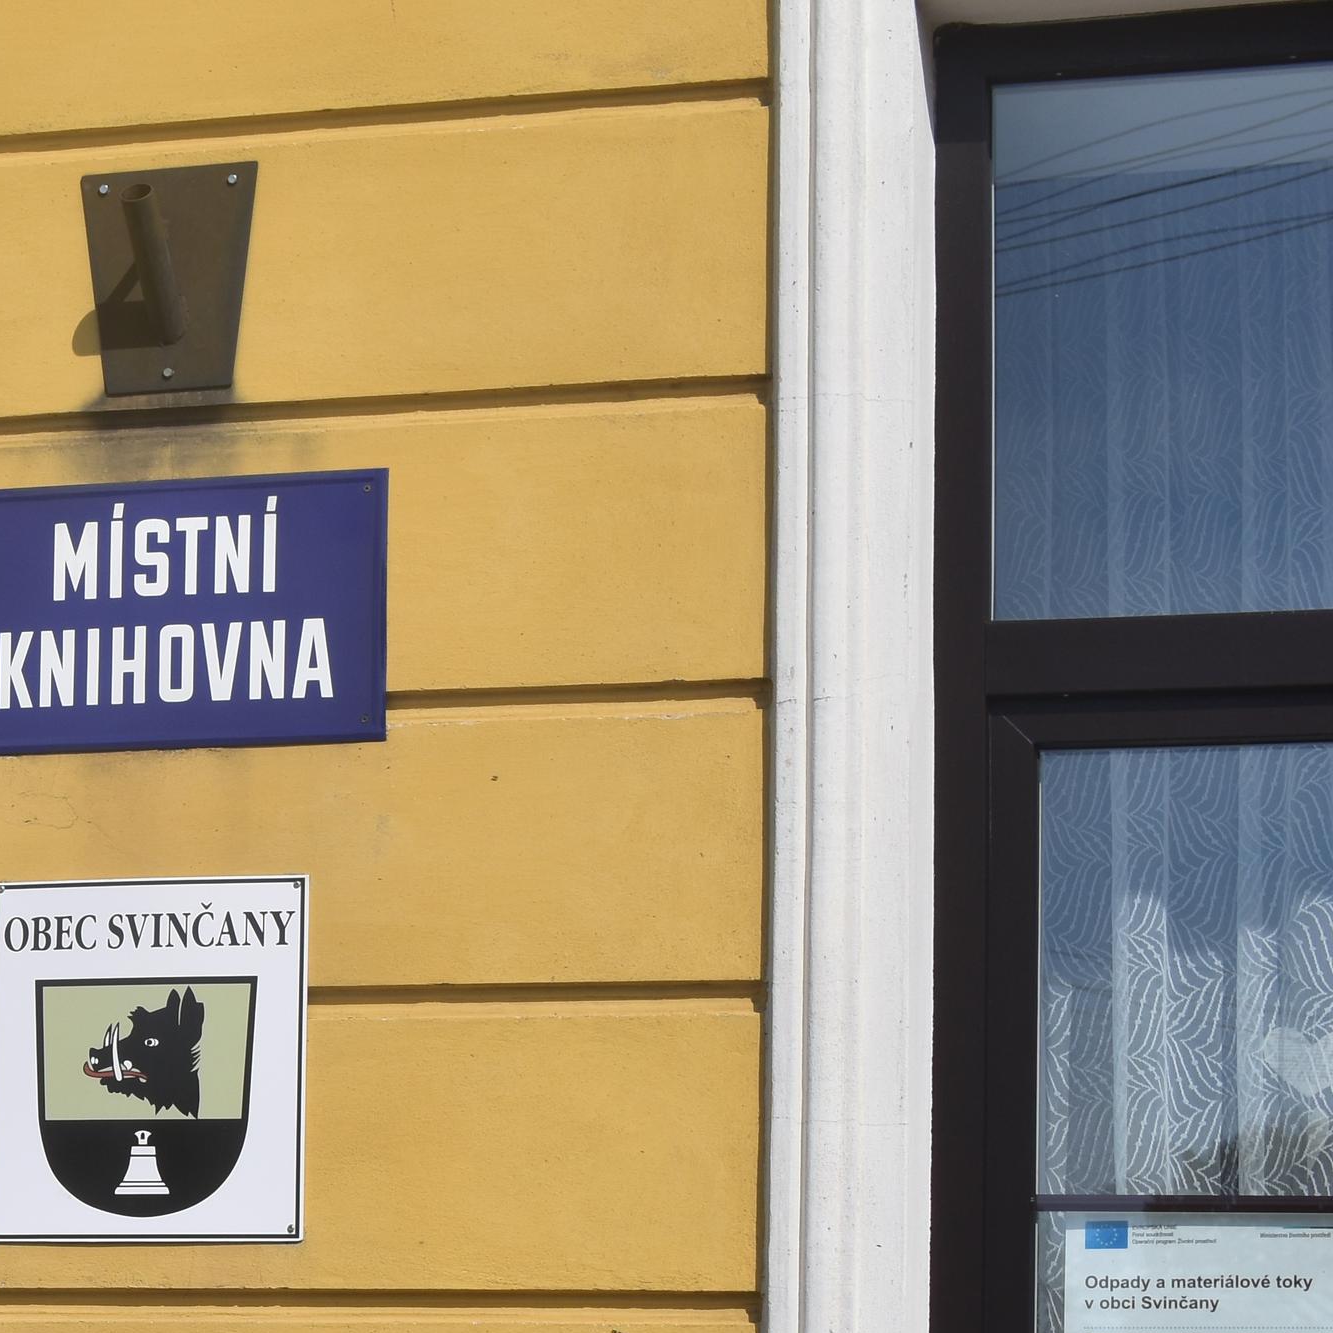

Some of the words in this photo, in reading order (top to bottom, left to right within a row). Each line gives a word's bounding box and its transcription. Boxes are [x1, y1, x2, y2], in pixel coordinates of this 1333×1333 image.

[52, 495, 278, 602] MÍSTNÍ
[3, 911, 98, 953] OBEC
[106, 902, 297, 949] SVINČANY
[1085, 1275, 1151, 1292] Odpady
[1156, 1278, 1166, 1289] a
[1171, 1274, 1271, 1289] materiálové
[1276, 1275, 1314, 1292] toky
[1085, 1299, 1094, 1309] v
[1099, 1296, 1136, 1310] obci
[1141, 1295, 1220, 1313] Svinčany
